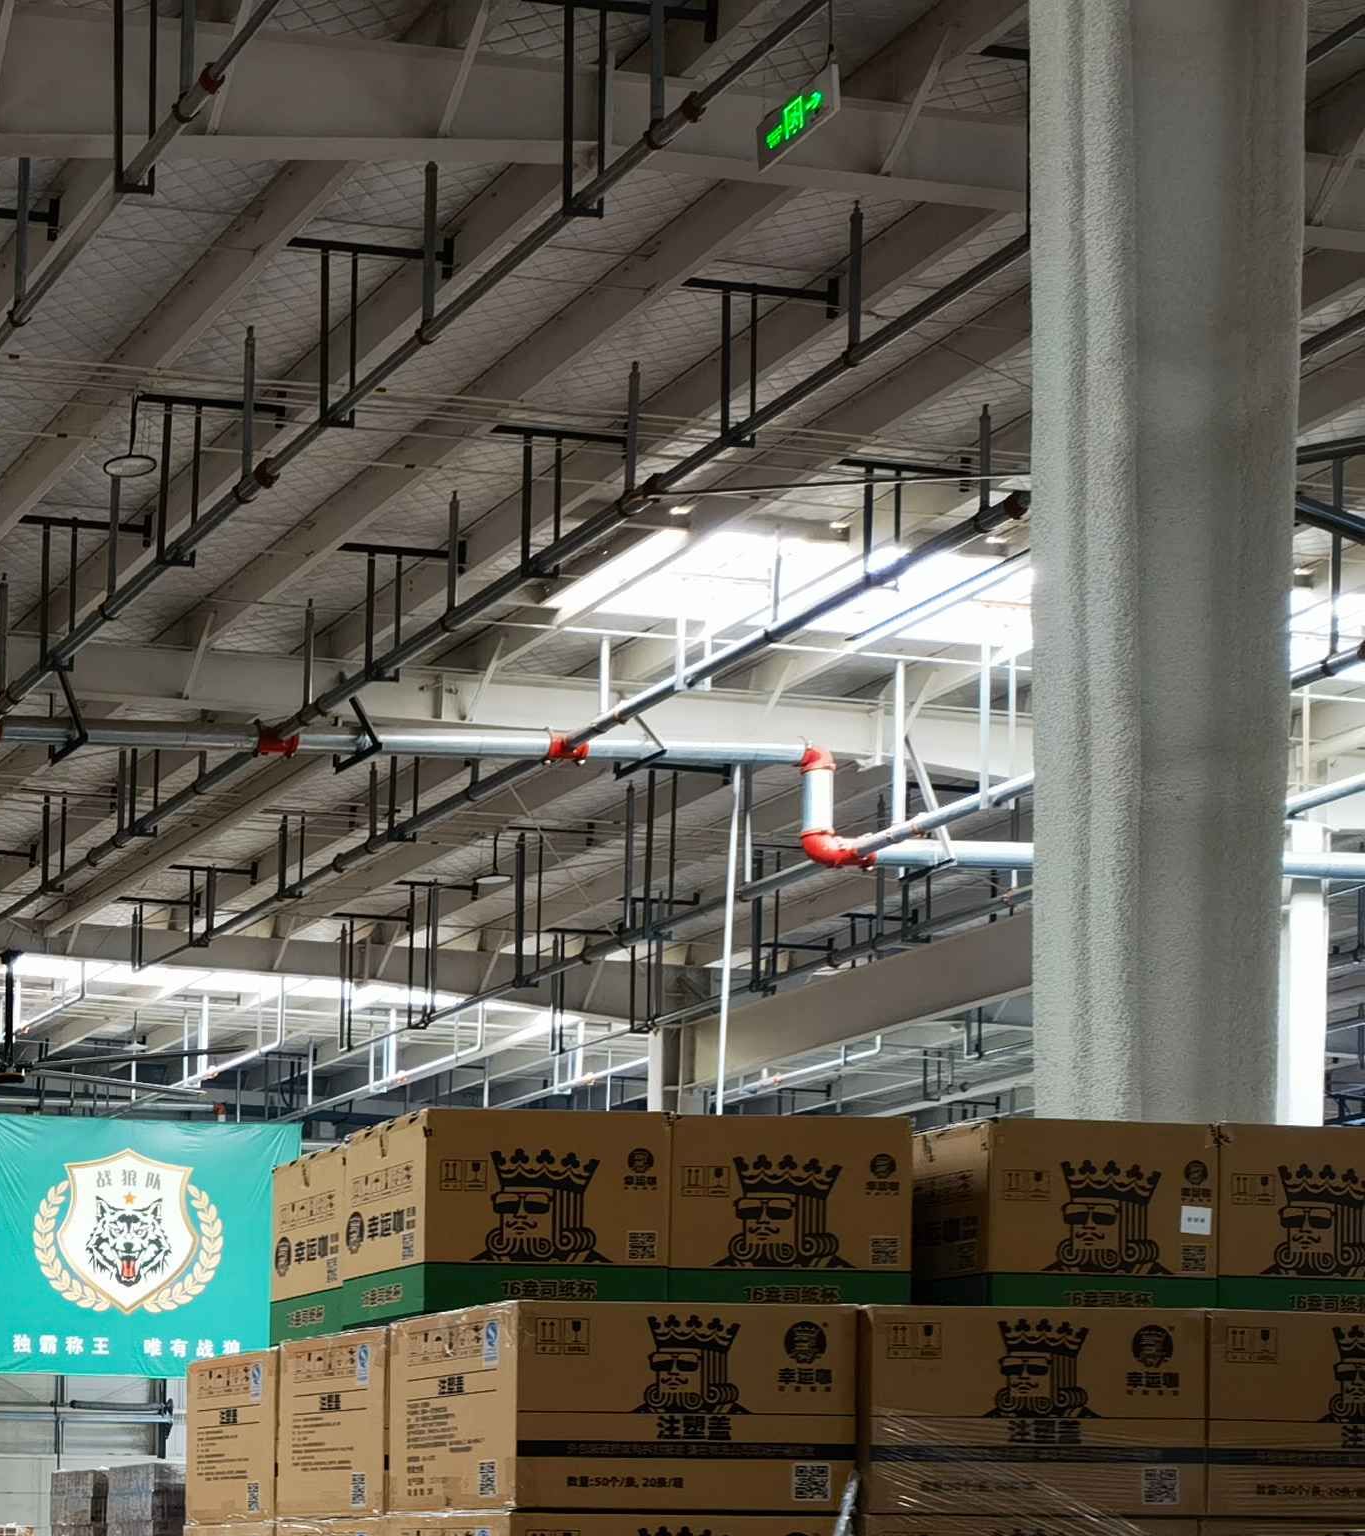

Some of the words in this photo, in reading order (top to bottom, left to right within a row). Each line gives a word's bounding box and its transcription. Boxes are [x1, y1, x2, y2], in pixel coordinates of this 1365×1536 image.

[95, 1168, 162, 1192] 战狼队
[1288, 1293, 1365, 1312] 16盎司纸
[12, 1333, 112, 1356] 独霸称王
[657, 1415, 731, 1440] 注塑盖
